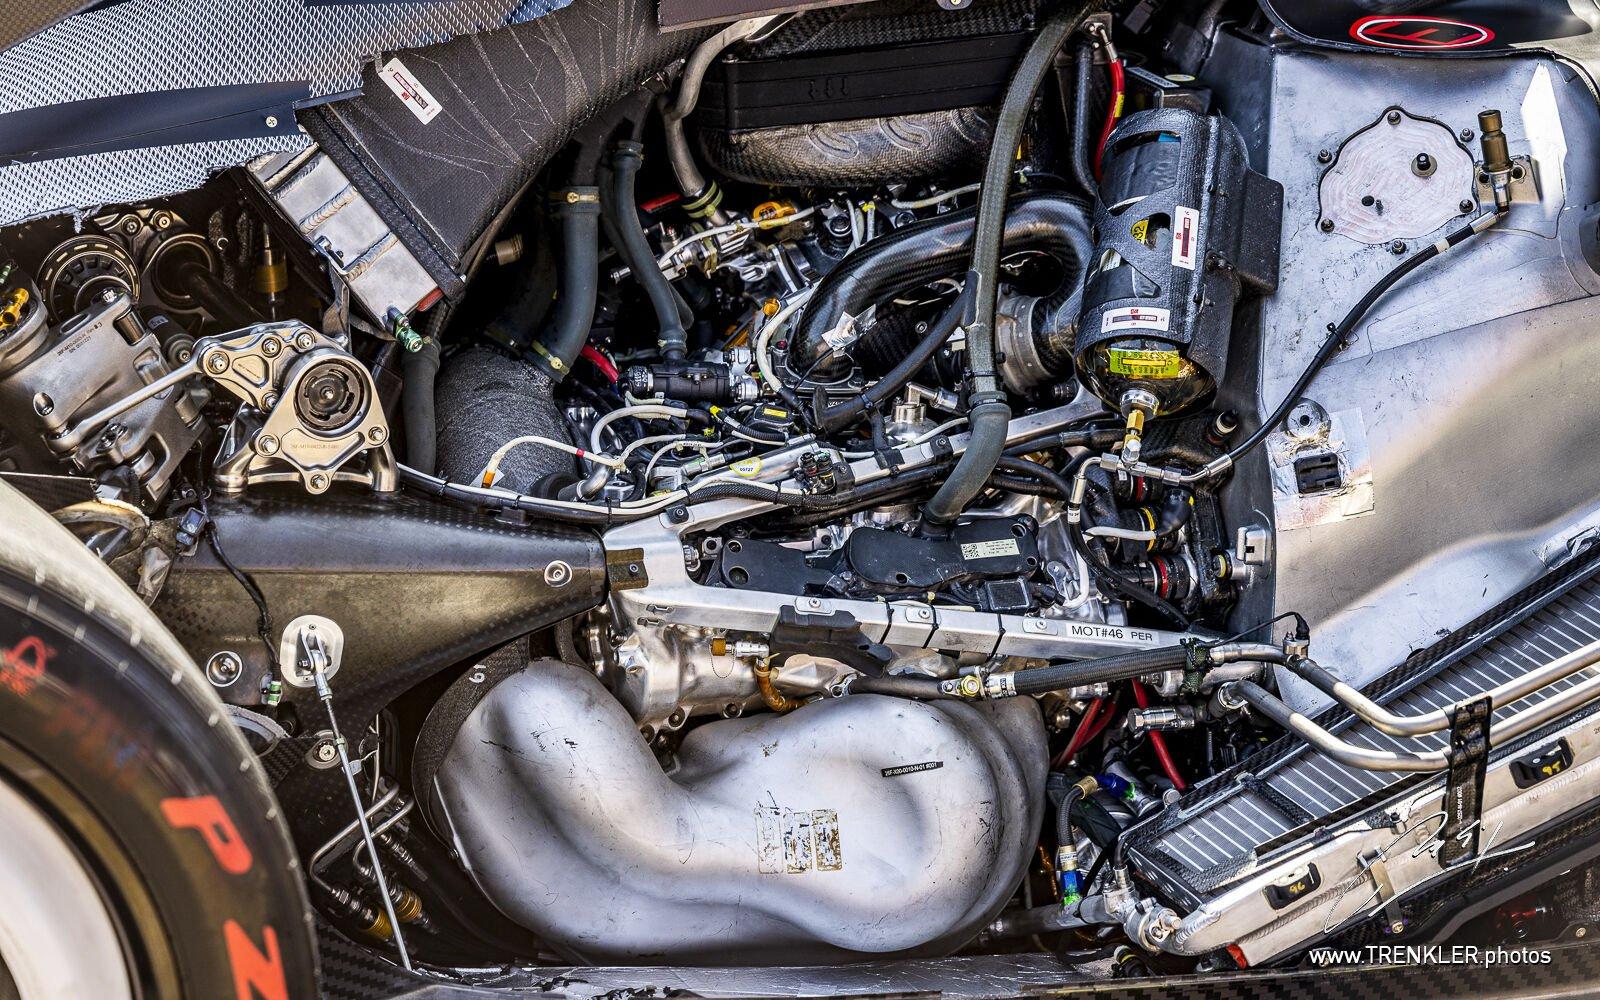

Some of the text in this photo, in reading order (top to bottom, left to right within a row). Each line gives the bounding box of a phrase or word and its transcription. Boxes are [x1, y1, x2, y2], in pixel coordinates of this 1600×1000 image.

[1071, 625, 1153, 641] MOT#46 PER
[160, 795, 252, 874] P
